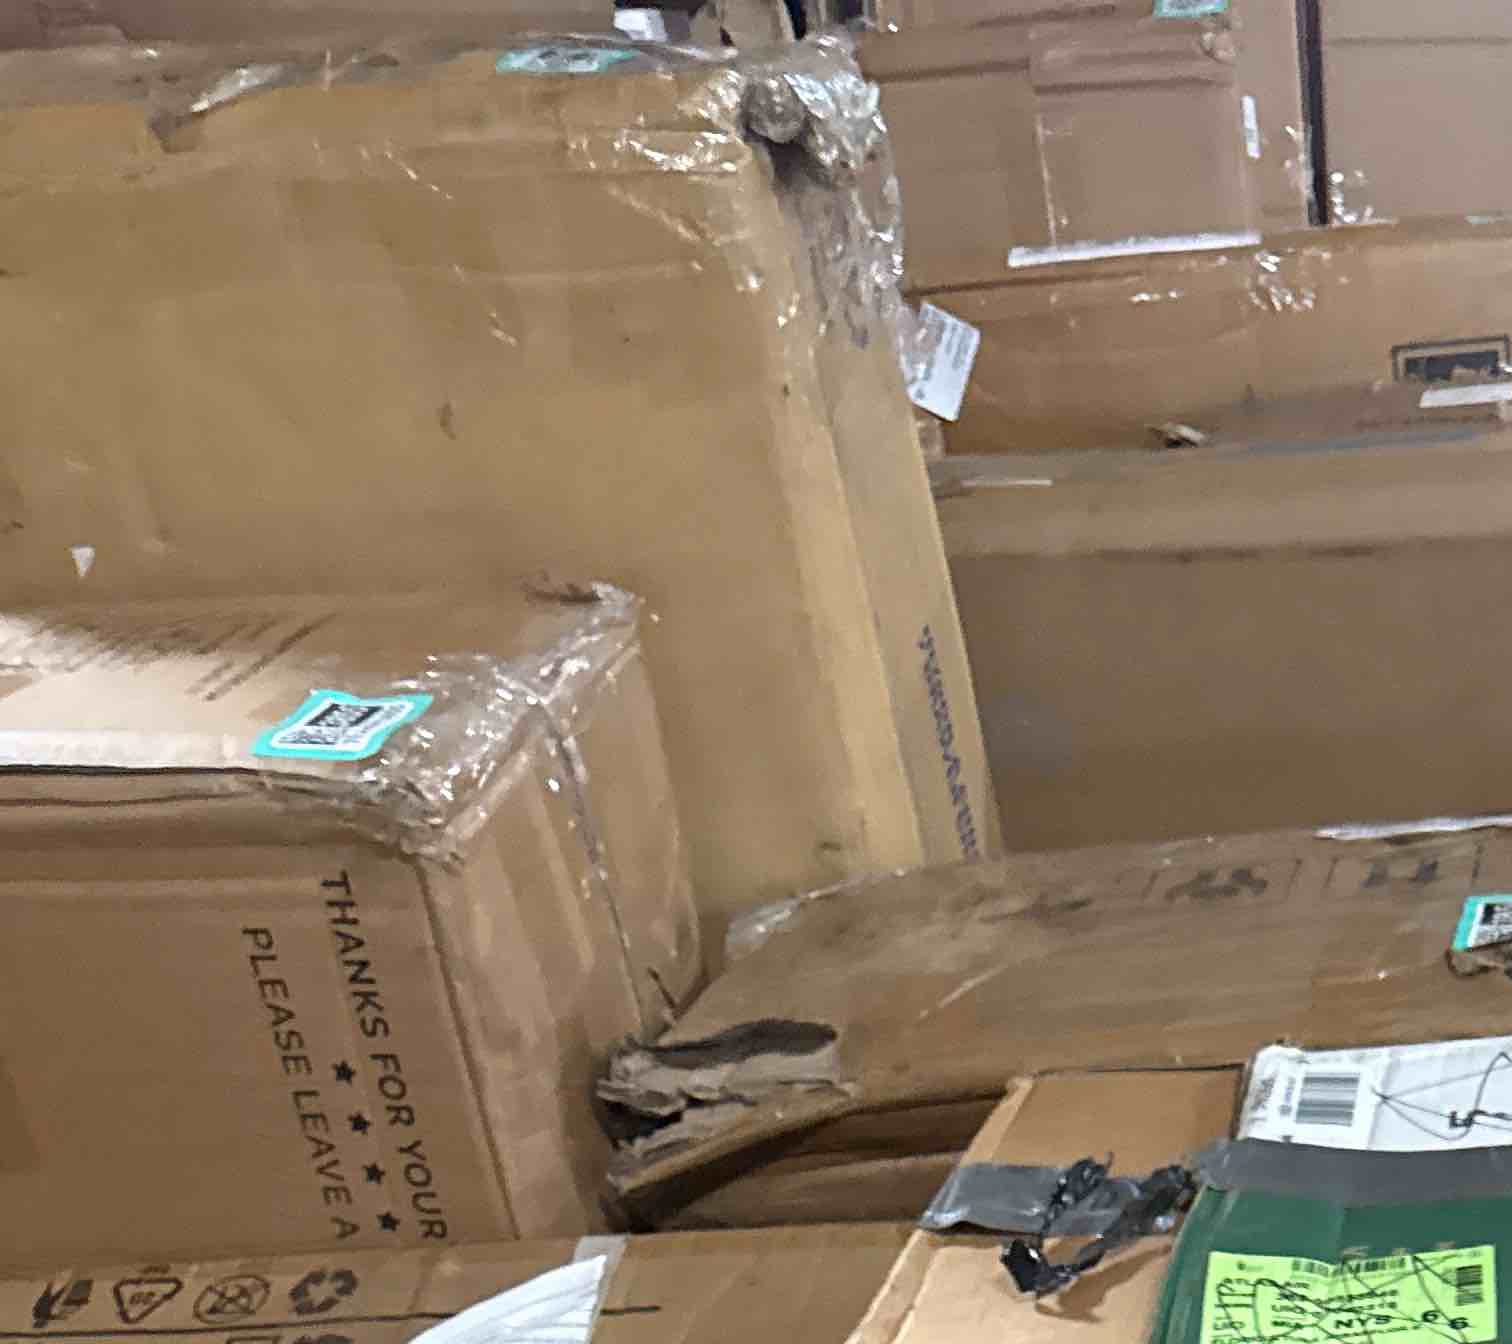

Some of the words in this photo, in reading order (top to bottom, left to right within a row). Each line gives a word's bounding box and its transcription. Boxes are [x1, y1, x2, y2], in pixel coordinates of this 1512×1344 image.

[240, 926, 313, 1077] PLEASE
[290, 1089, 353, 1206] LEAVE
[330, 1217, 360, 1241] A
[320, 871, 390, 1040] THANKS
[367, 1051, 417, 1128] FOR
[396, 1139, 450, 1240] YOUR
